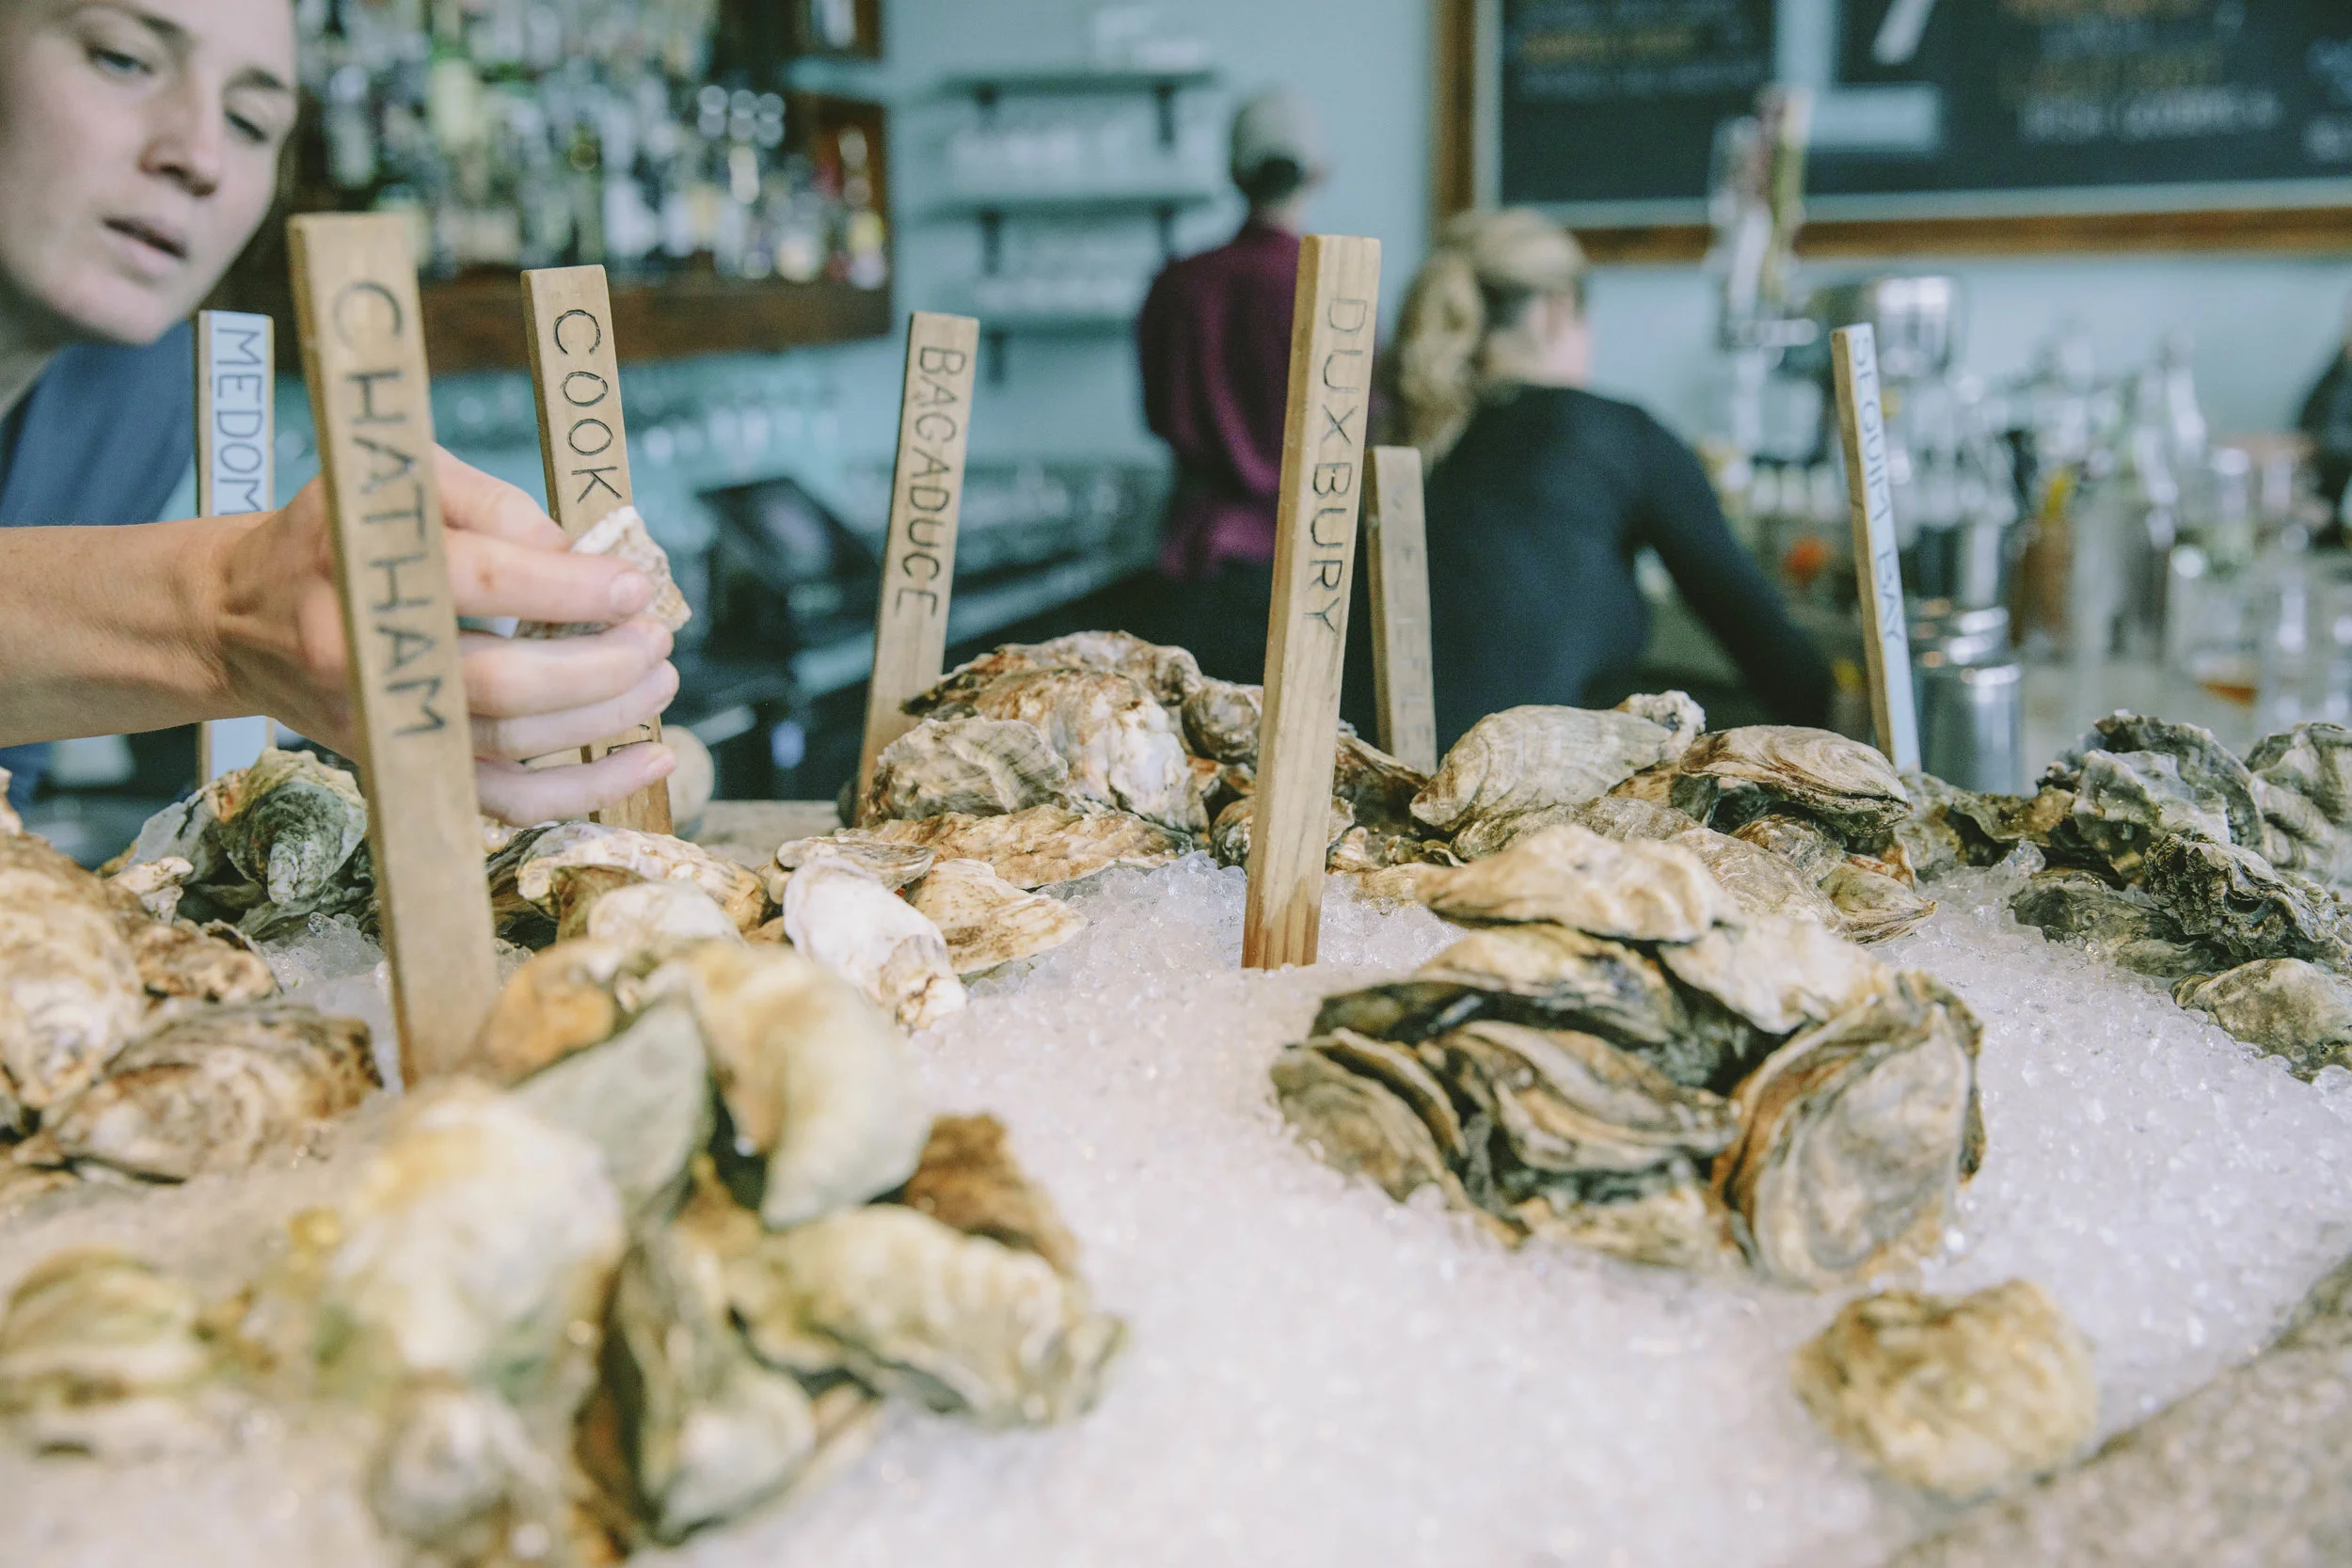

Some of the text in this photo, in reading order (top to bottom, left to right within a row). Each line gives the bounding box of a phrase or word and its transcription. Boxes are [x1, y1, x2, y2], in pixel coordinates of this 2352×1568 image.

[330, 280, 447, 737] CHATHAM
[552, 309, 622, 503] COOK
[895, 344, 966, 620] BAGADUCE
[1301, 297, 1368, 633] DUXBURY
[1852, 336, 1904, 641] SEQUIM BAY
